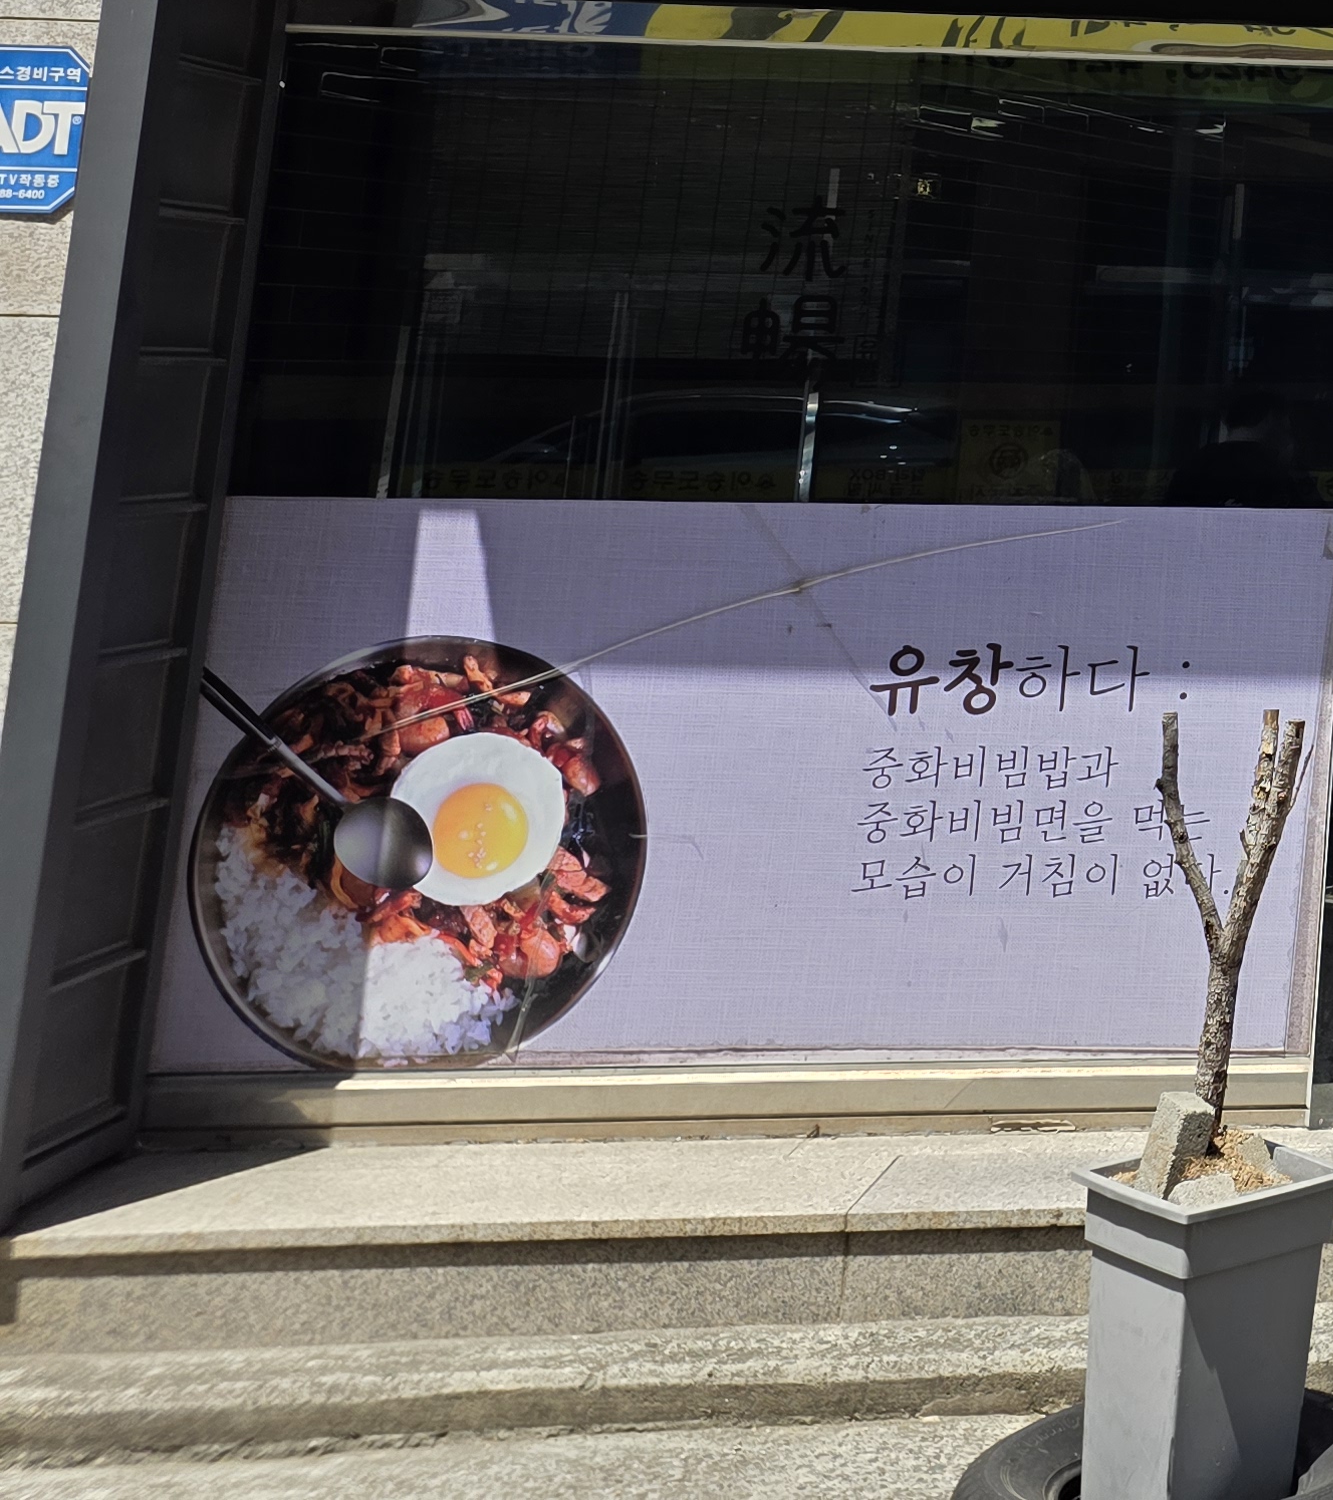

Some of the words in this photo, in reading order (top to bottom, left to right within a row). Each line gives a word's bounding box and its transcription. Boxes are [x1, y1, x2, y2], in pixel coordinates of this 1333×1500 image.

[0, 66, 81, 82] 스경비구역
[870, 643, 1150, 716] 유창하다
[862, 745, 1121, 790] 중화비빔밥과
[857, 800, 1114, 844] 중화비빔면을
[851, 853, 979, 900] 모습이
[998, 853, 1119, 896] 거침이
